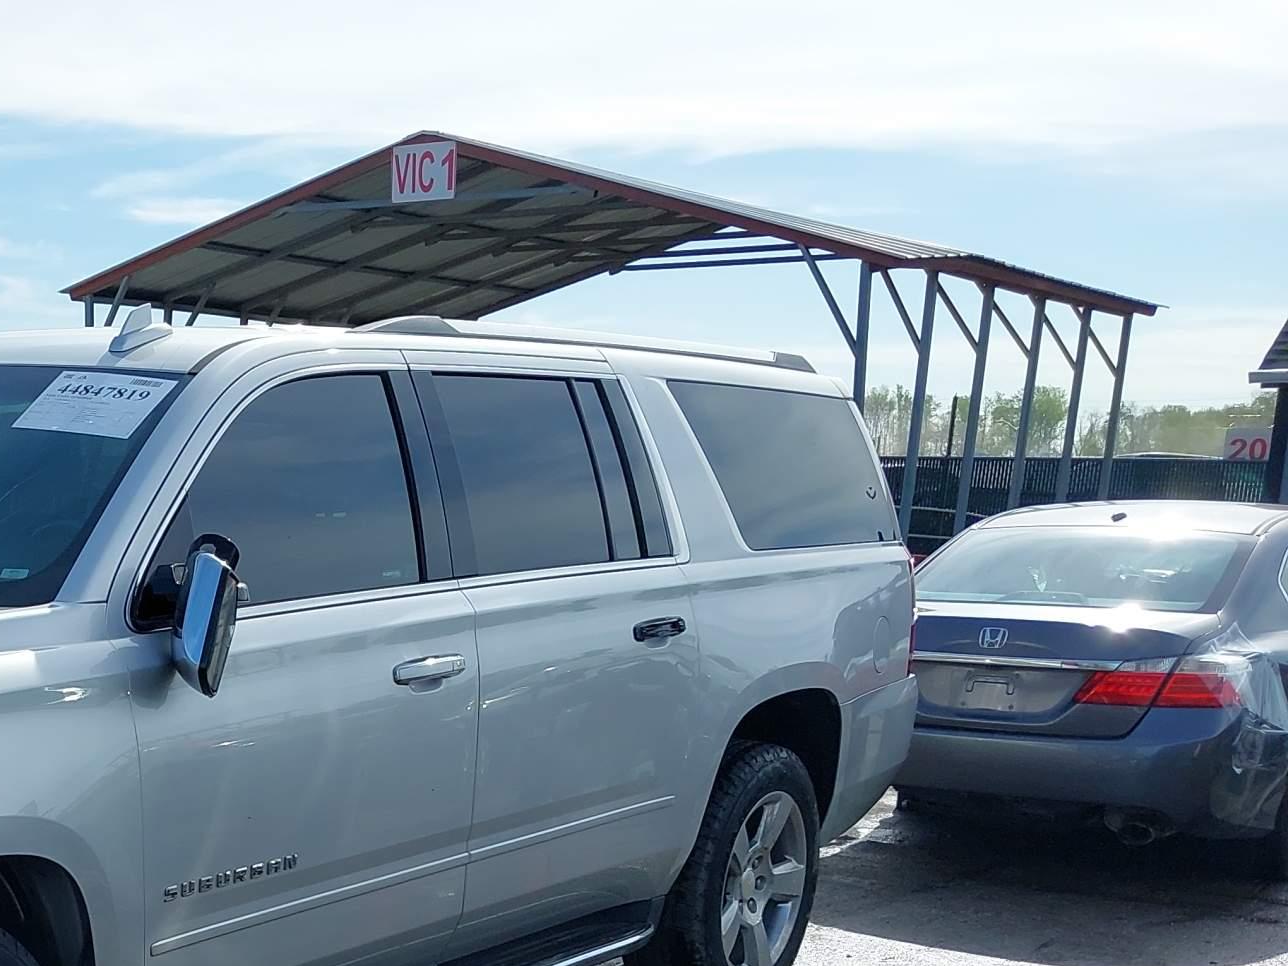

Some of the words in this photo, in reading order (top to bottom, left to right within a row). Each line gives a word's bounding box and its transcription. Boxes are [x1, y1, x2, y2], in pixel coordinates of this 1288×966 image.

[394, 150, 435, 194] VIC
[441, 148, 454, 191] 1
[57, 383, 151, 402] 44847819
[1228, 438, 1268, 460] 20
[163, 853, 299, 903] SUBURBAN
